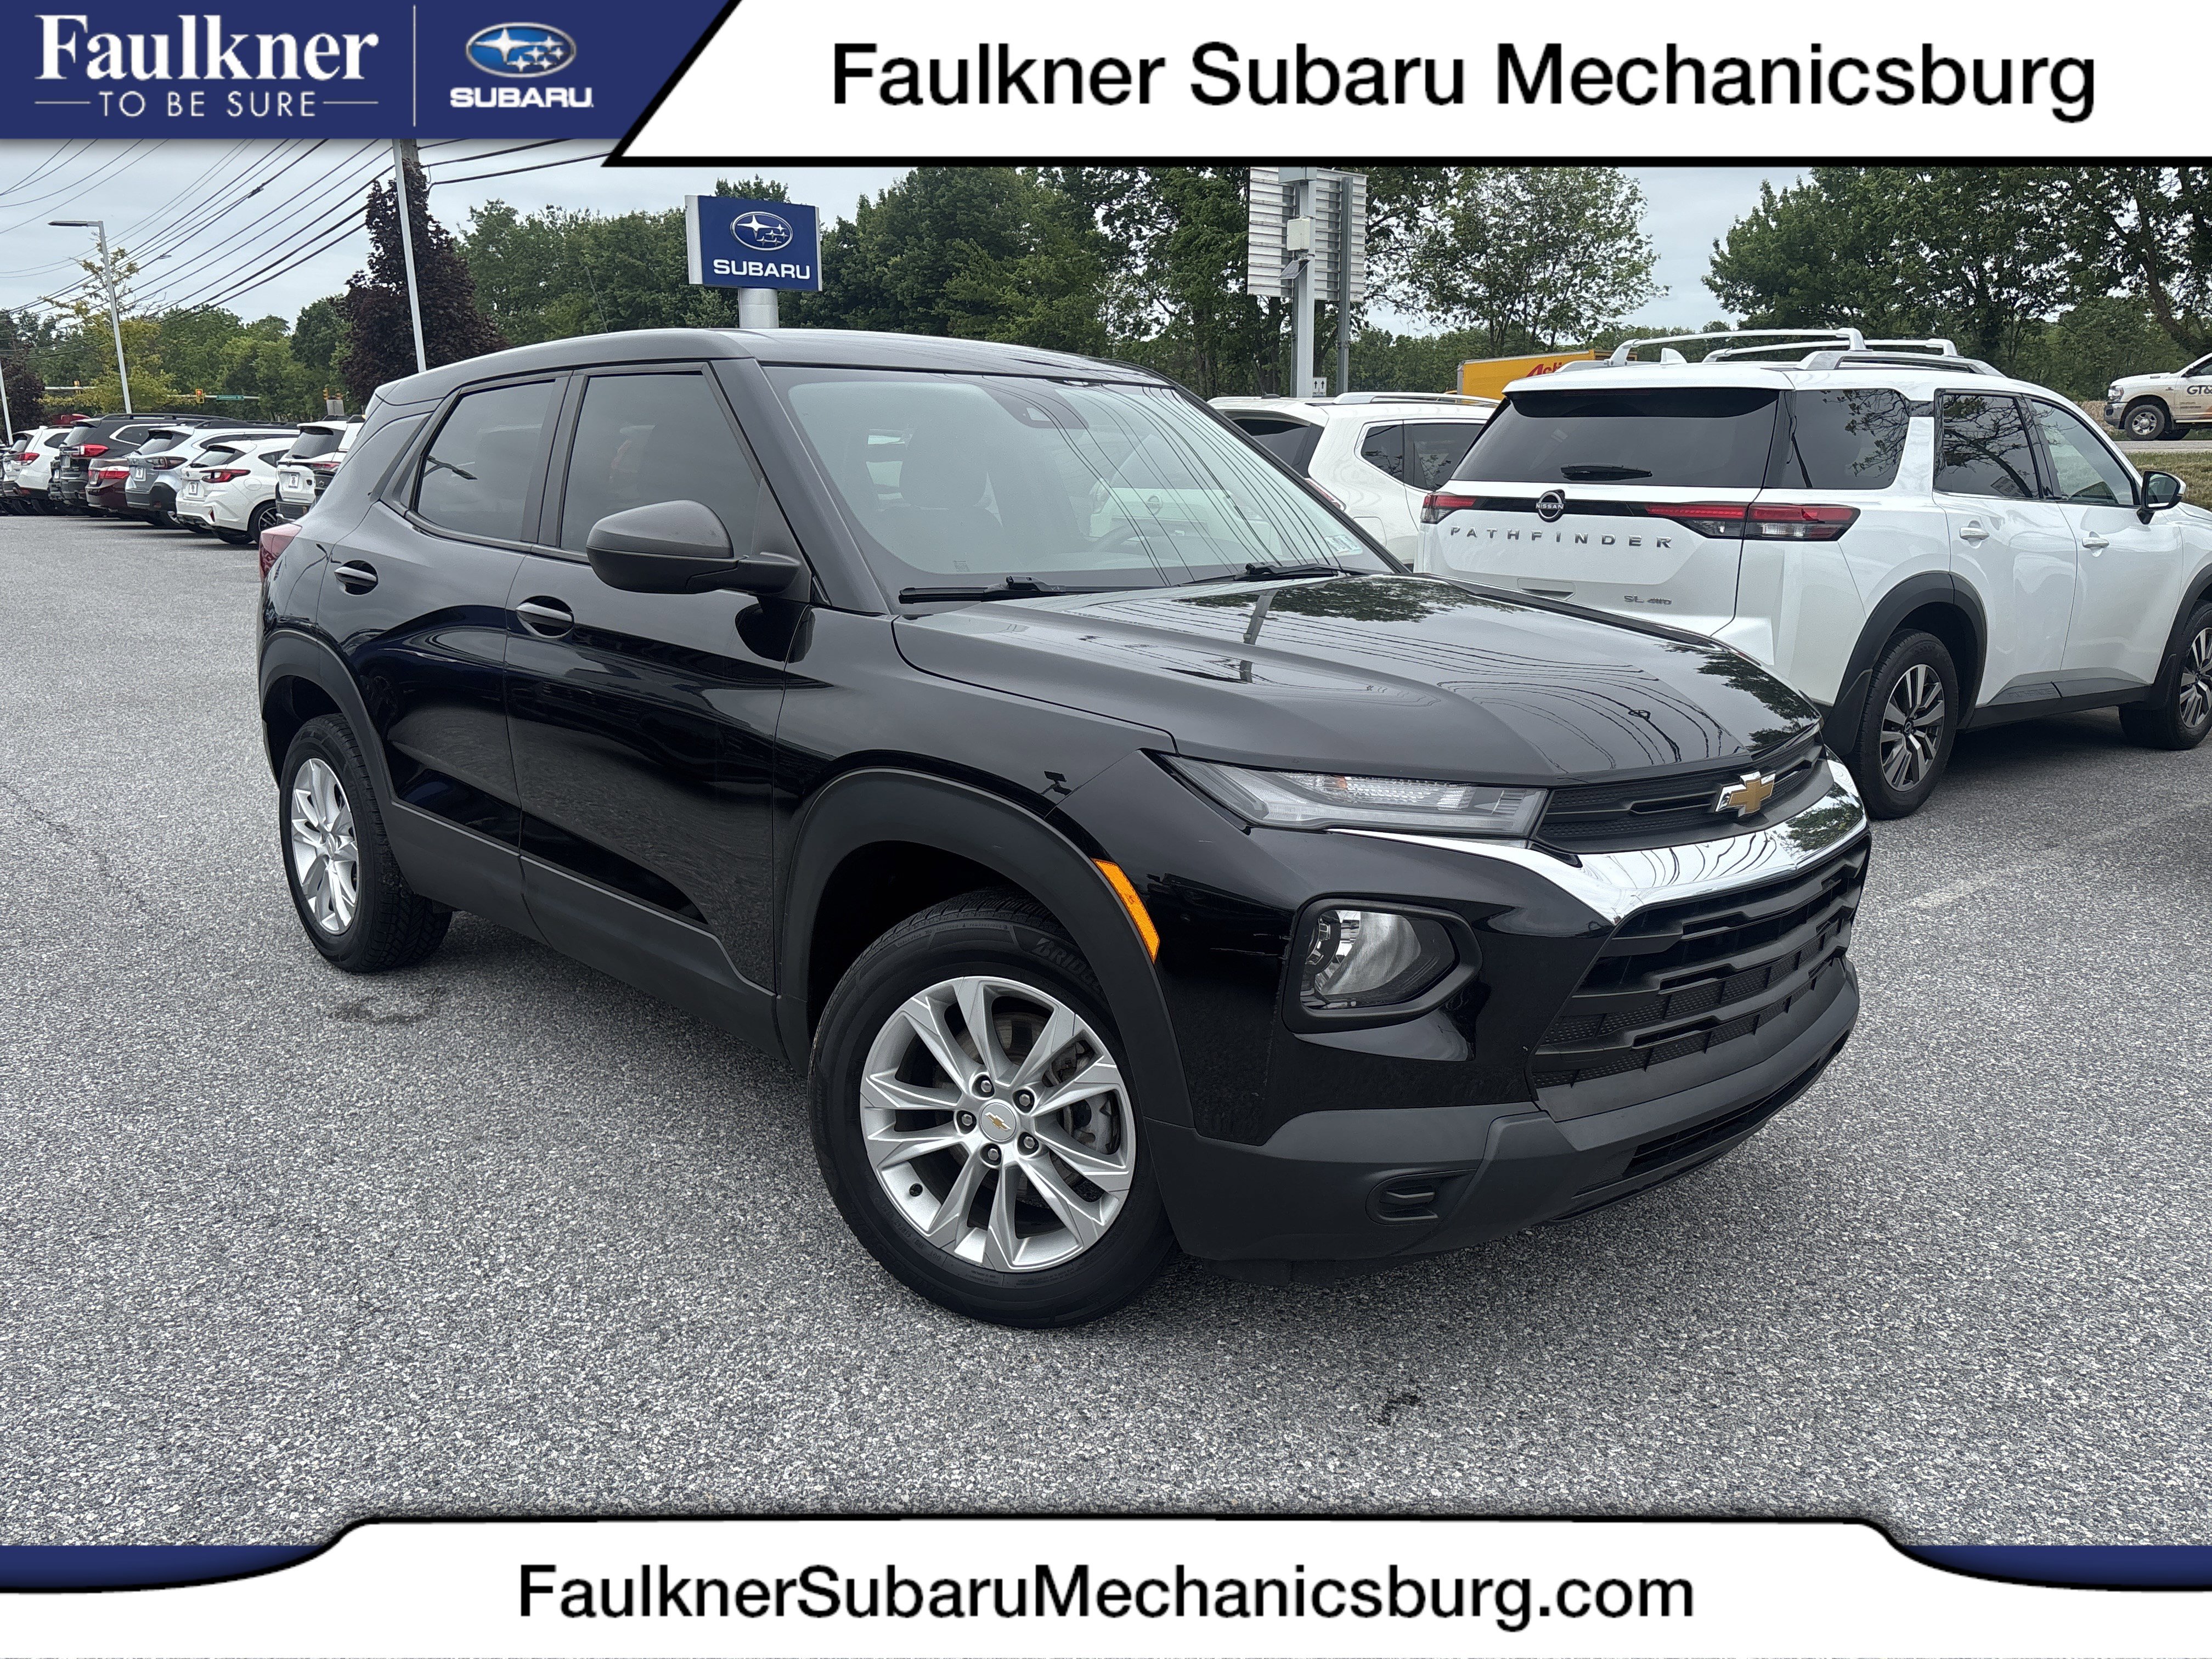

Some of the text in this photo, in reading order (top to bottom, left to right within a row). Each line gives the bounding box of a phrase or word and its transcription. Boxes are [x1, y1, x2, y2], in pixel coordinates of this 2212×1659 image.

[713, 259, 811, 280] SUBARU
[1450, 526, 1672, 549] PATHFINDER
[1624, 594, 1645, 603] SL
